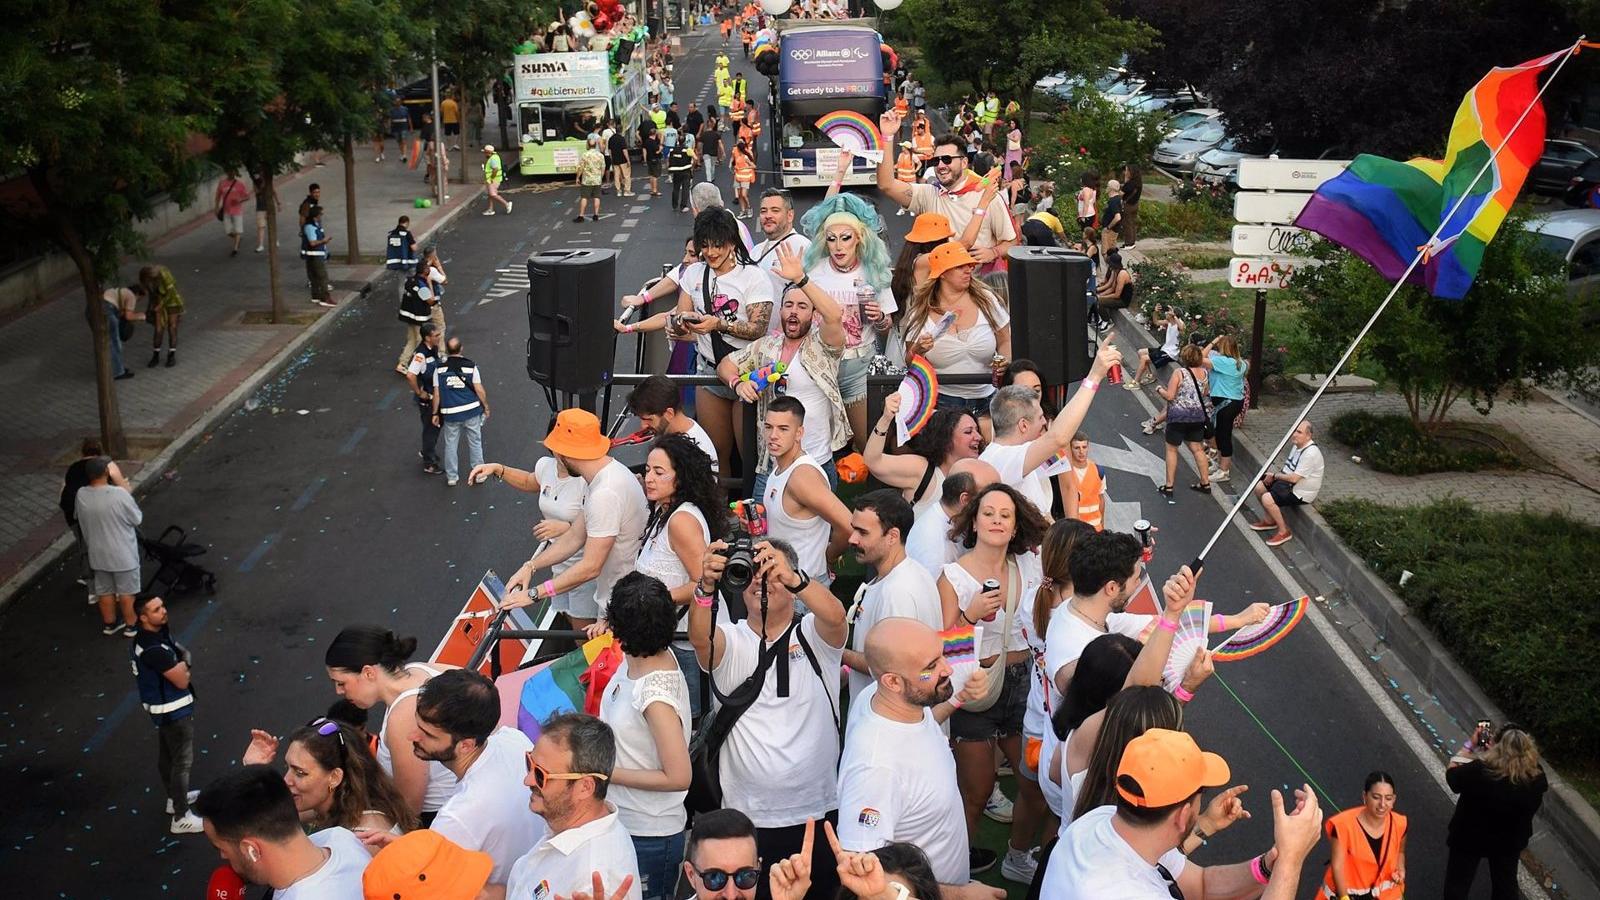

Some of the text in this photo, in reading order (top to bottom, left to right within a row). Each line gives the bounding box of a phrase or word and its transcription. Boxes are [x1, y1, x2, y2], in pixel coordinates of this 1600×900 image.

[787, 87, 802, 95] Get
[802, 86, 824, 96] ready
[847, 84, 876, 93] PROUD
